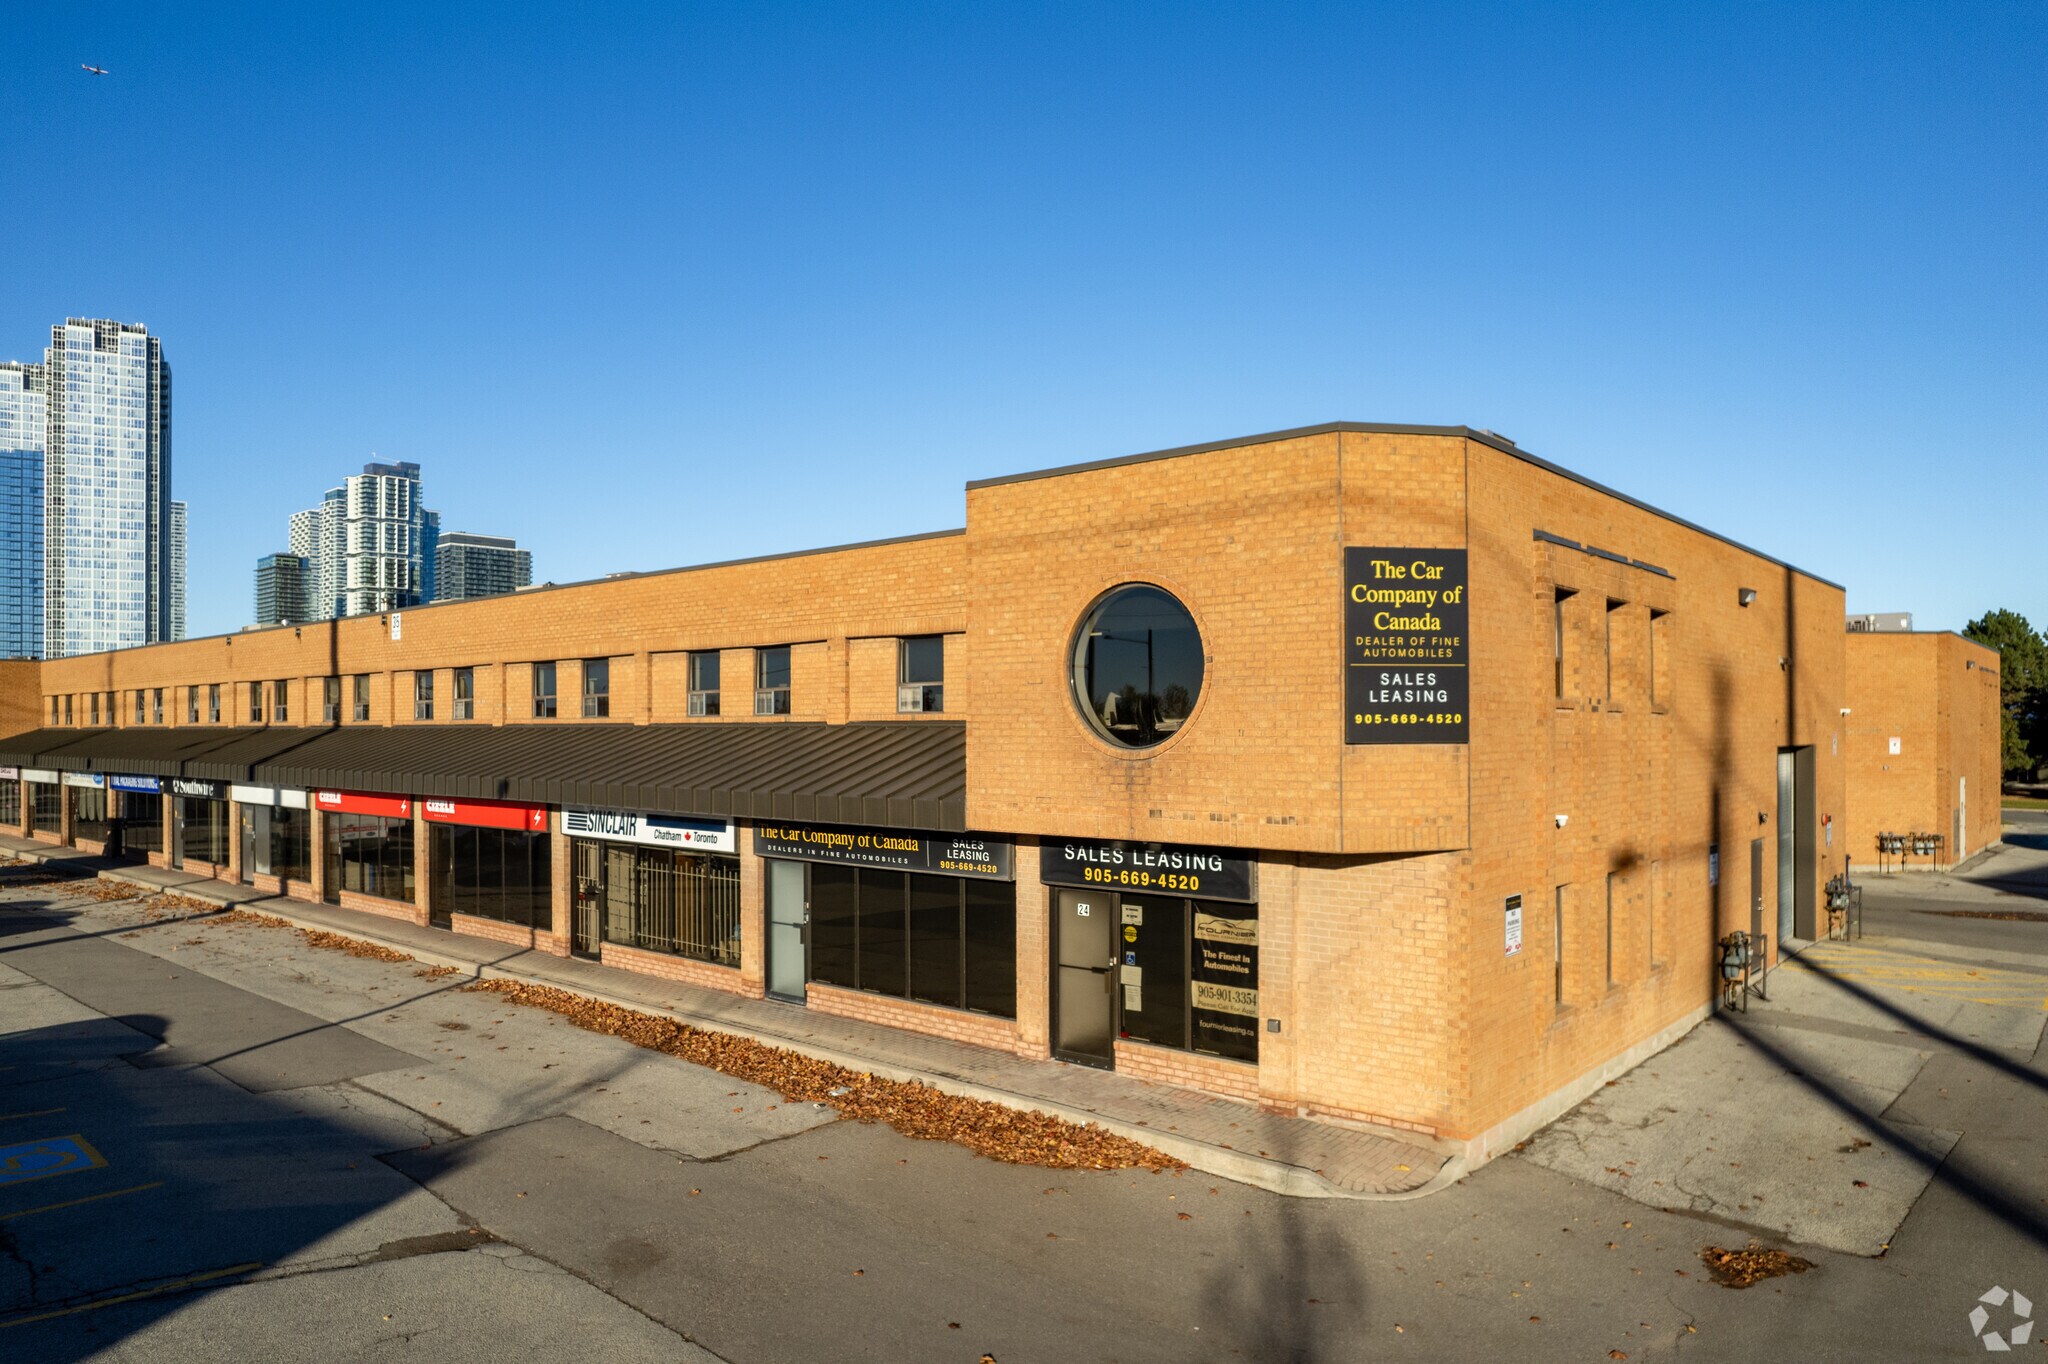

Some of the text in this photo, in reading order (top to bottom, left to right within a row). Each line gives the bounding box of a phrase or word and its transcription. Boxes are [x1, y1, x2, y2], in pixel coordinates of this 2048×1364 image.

[1371, 560, 1444, 579] The Car
[1351, 584, 1463, 608] Company of
[1374, 611, 1441, 631] Canada
[1356, 636, 1460, 647] DEALER OF FINE
[1364, 648, 1453, 658] AUTOMOBILES
[1380, 672, 1437, 686] SALES
[1369, 690, 1448, 703] LEASING
[1355, 714, 1462, 725] 905-669-4520
[180, 779, 214, 796] Southwire
[587, 809, 638, 837] SINCLAIR
[653, 828, 718, 844] Chatham Toronto
[758, 823, 919, 852] The Car Company of Canada
[952, 838, 984, 850] SALES
[767, 844, 803, 855] DEALERS
[820, 850, 841, 858] FINE
[845, 853, 910, 865] AUTOMOBILES
[946, 849, 990, 862] LEASING
[1064, 844, 1223, 872] SALES LEASING
[940, 860, 998, 874] 905-669-4520
[1084, 867, 1200, 891] 905-669-4520
[1197, 926, 1256, 938] FOURNIER
[1203, 949, 1217, 958] The
[1218, 951, 1241, 962] Finest
[1203, 960, 1250, 973] Automobiles
[1198, 985, 1257, 1006] 905-901-3354
